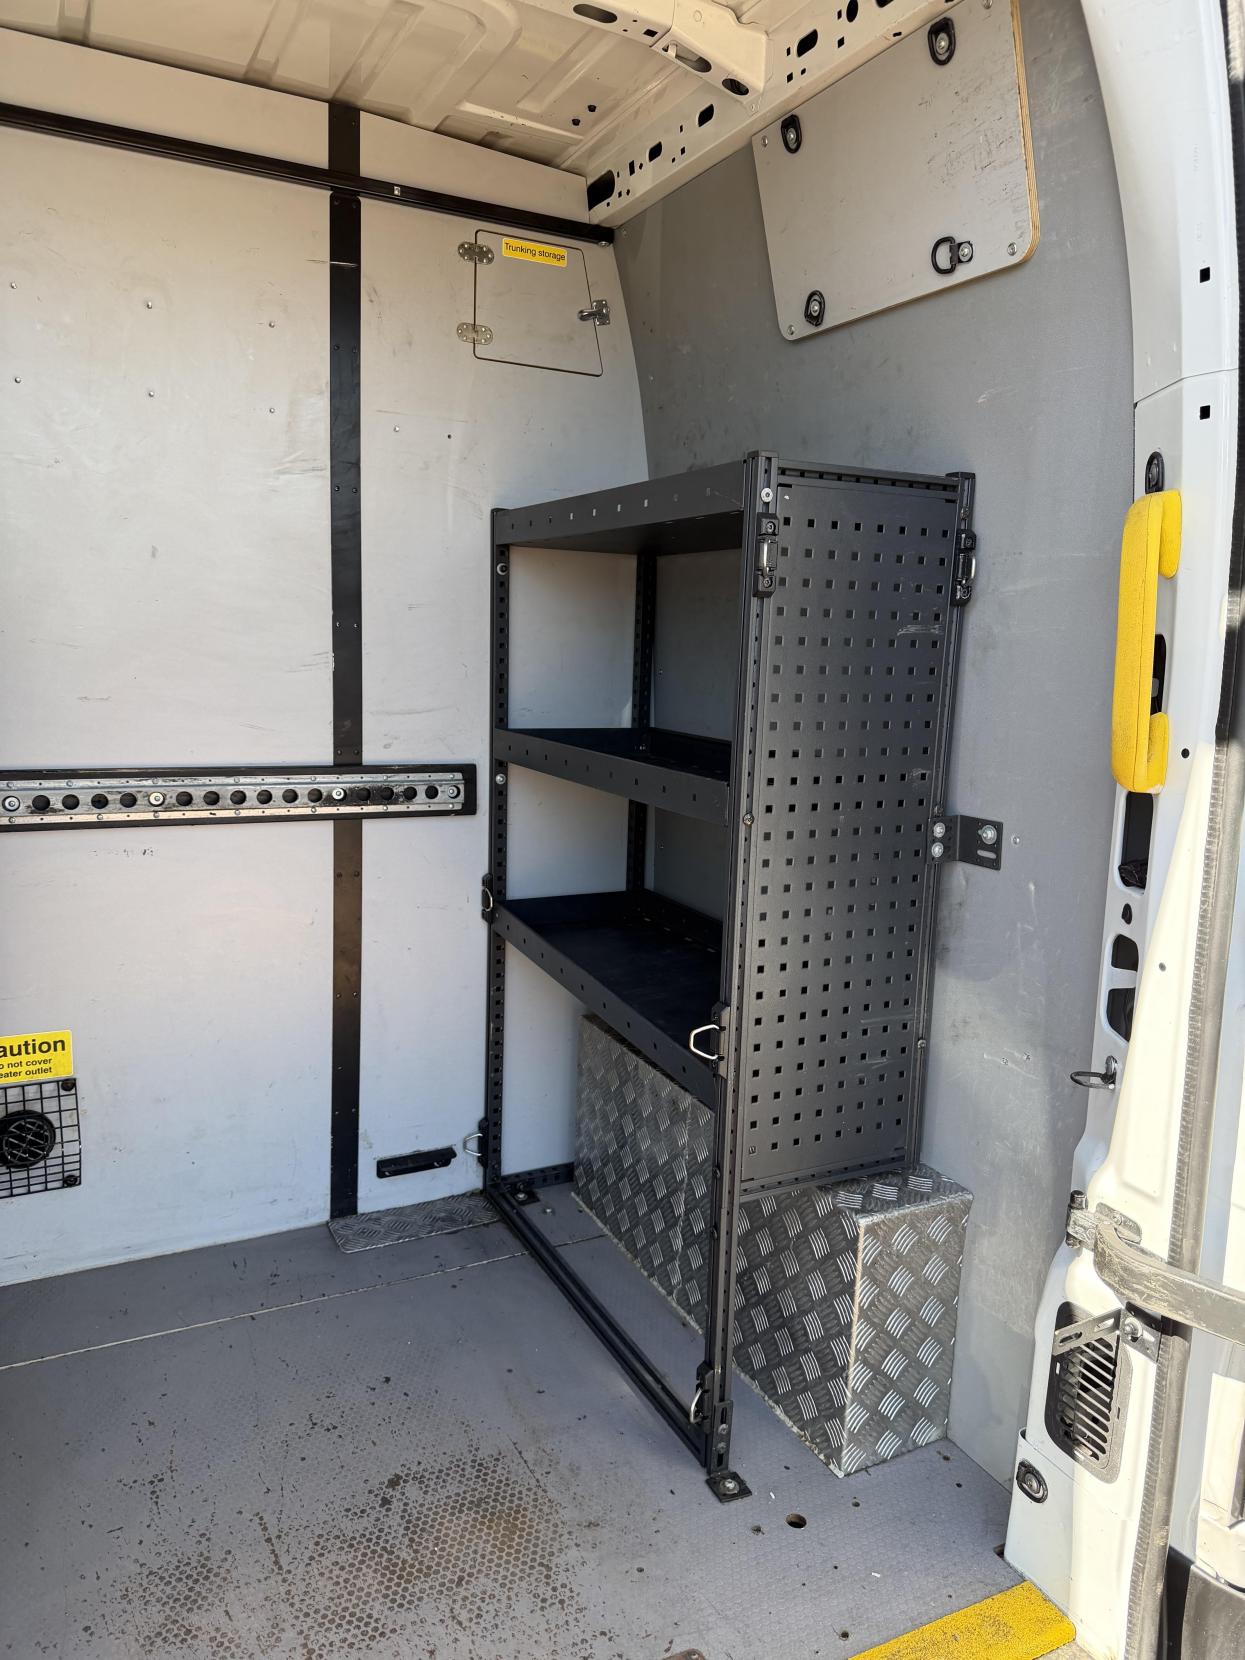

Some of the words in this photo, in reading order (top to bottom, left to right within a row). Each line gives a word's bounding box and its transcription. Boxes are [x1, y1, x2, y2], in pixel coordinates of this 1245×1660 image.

[505, 242, 537, 257] Trunking
[538, 249, 566, 261] storage
[7, 1060, 22, 1068] not
[25, 1058, 52, 1066] cover
[25, 1067, 52, 1075] outlet
